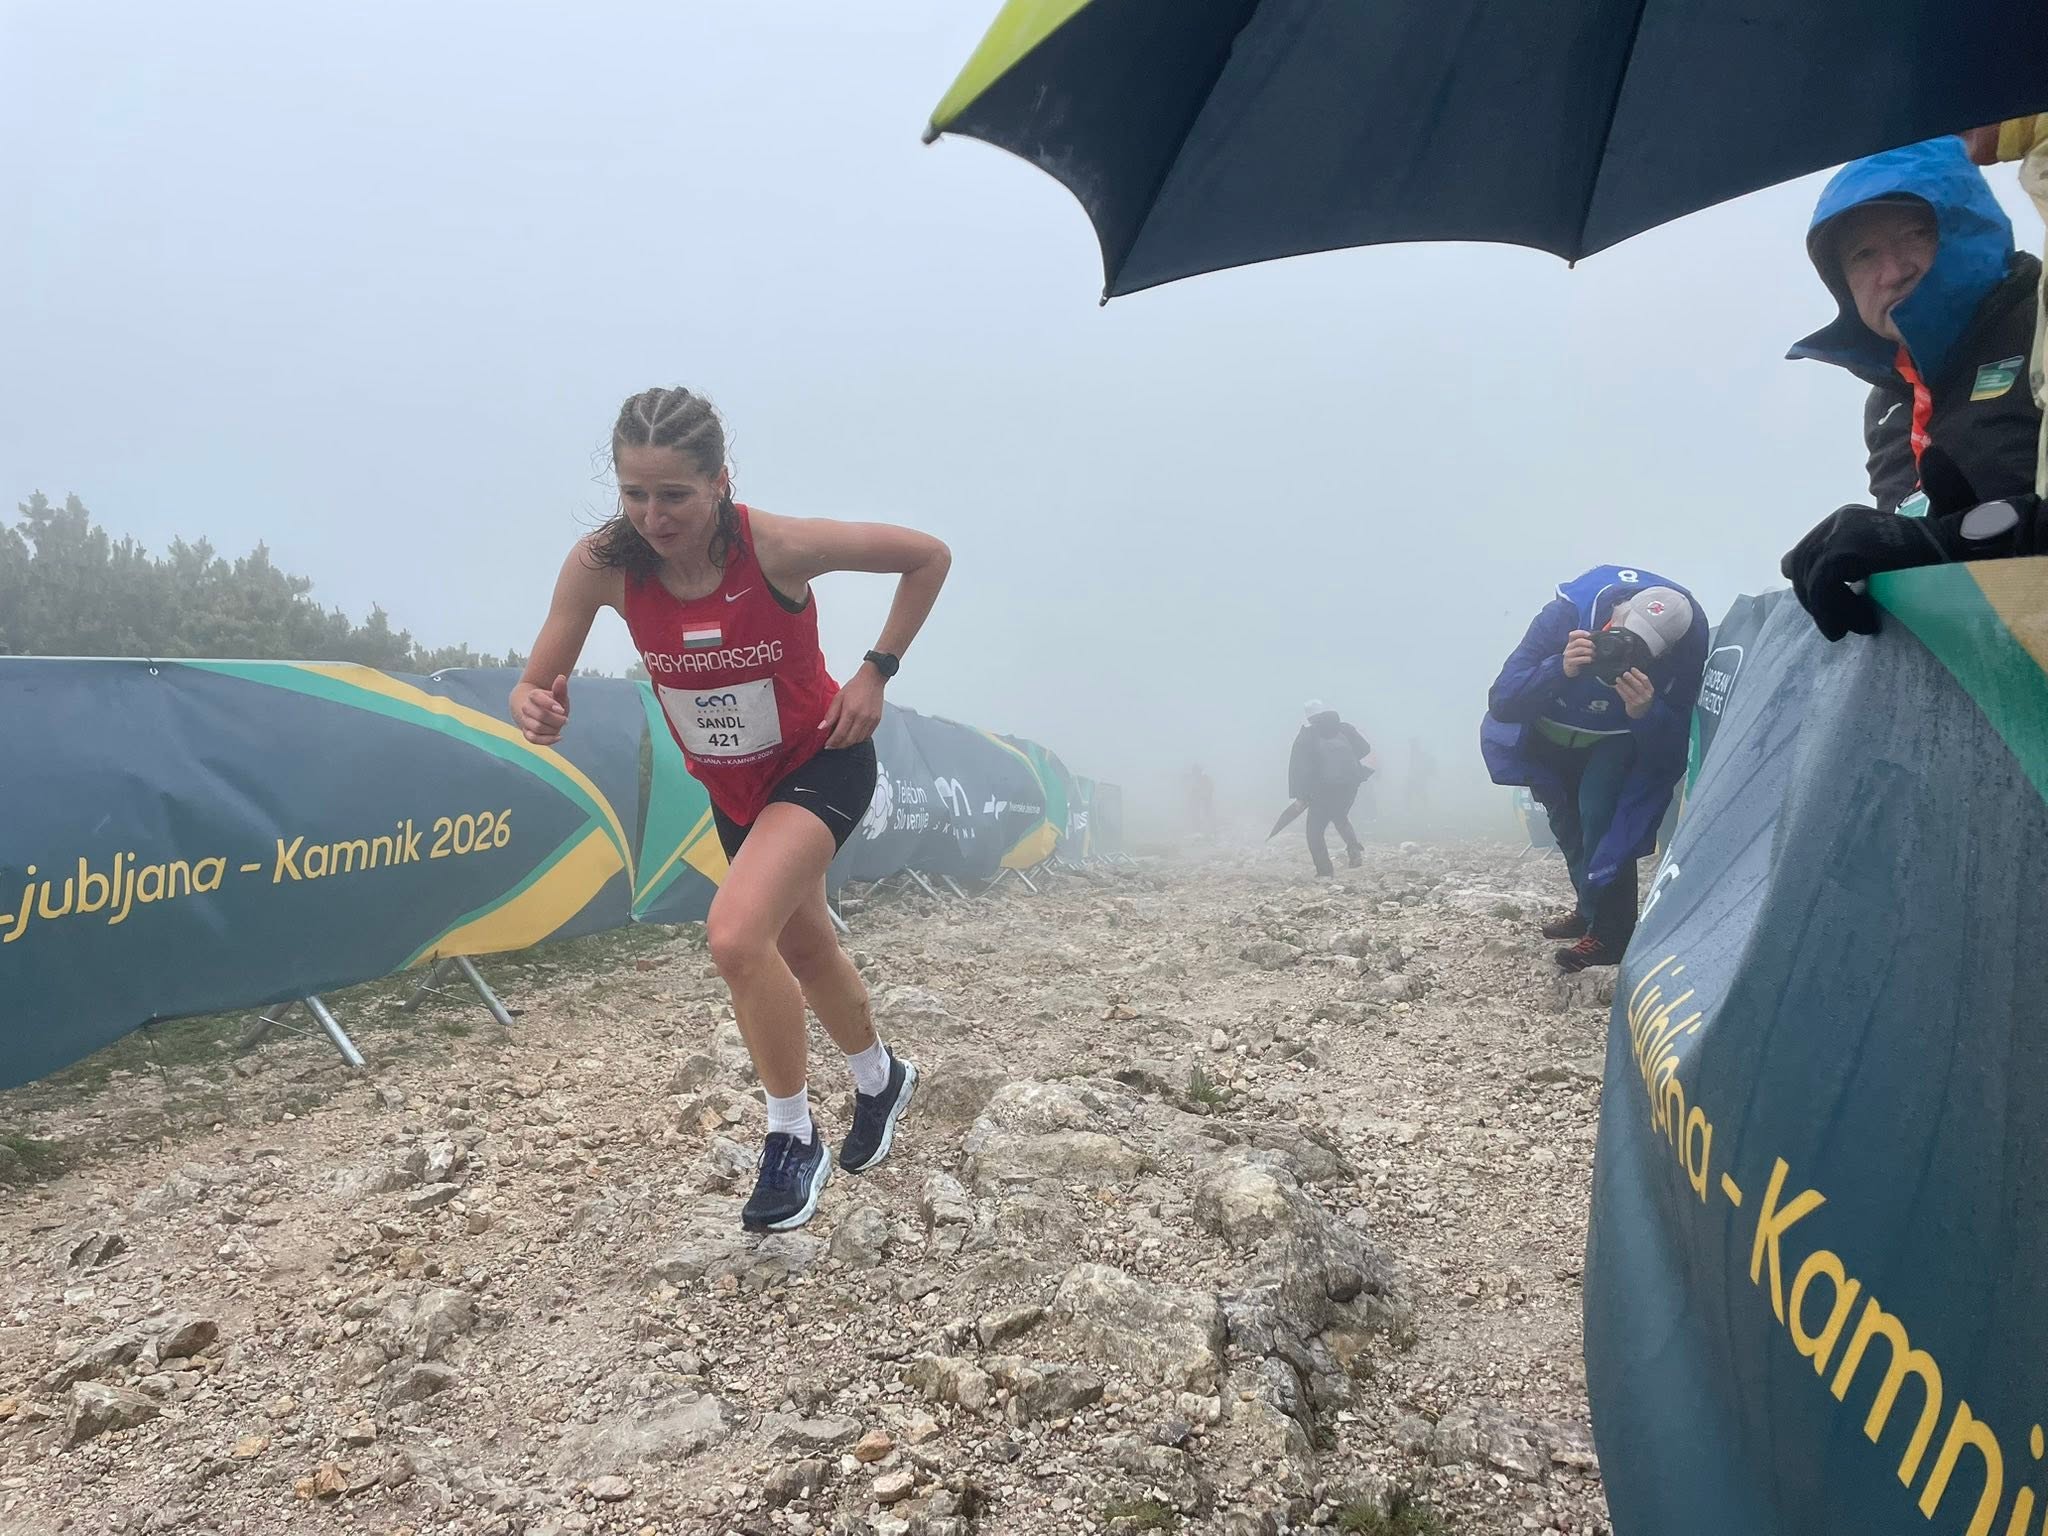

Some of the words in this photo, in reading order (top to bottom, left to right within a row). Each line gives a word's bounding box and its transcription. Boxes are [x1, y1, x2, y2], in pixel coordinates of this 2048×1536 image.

[697, 716, 746, 729] SANDL
[708, 733, 739, 747] 421
[273, 819, 422, 883] Kamnik
[430, 809, 512, 859] 2026
[1750, 1156, 2048, 1536] Kamni
